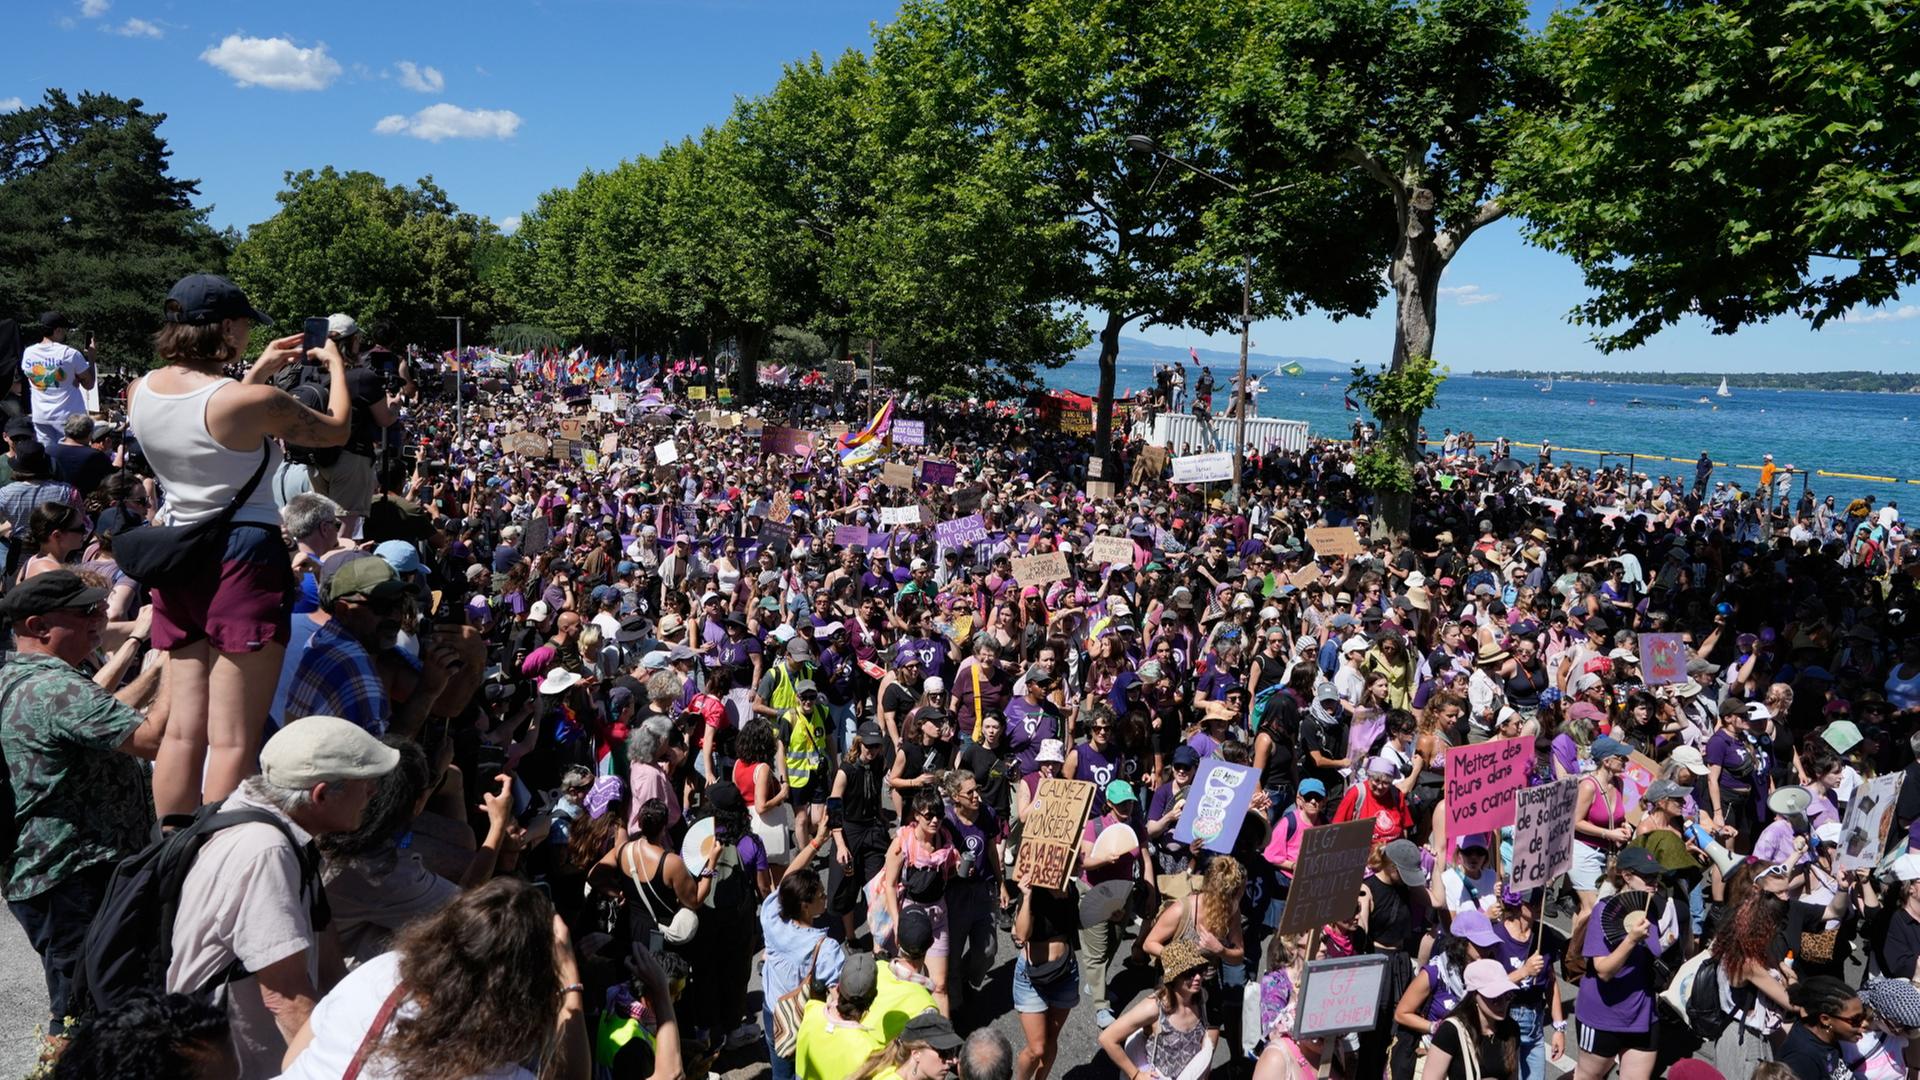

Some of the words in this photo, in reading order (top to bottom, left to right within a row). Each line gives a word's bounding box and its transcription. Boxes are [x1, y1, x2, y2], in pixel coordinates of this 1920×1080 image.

[25, 357, 64, 368] Sevilla
[937, 514, 979, 535] FACHOS
[940, 535, 953, 547] AU
[1454, 751, 1498, 778] Mettez
[1502, 740, 1522, 761] des
[1039, 780, 1087, 801] CALMEZ
[1447, 777, 1482, 807] fleurs
[1487, 764, 1513, 785] dans
[1045, 800, 1072, 819] VOUS
[1451, 801, 1477, 824] vos
[1517, 808, 1531, 832] de
[1025, 814, 1075, 841] MONSIEUR
[1306, 830, 1320, 855] LE
[1321, 826, 1340, 849] G7
[1529, 829, 1543, 855] de
[1035, 842, 1044, 864] VA
[1045, 844, 1067, 869] BIEN
[1017, 863, 1032, 880] SE
[1030, 864, 1064, 887] PASSER
[1512, 859, 1528, 884] et
[1529, 853, 1545, 882] de
[1298, 869, 1355, 901] EXPLOITE
[1291, 902, 1313, 926] ET
[1330, 968, 1357, 996] G7
